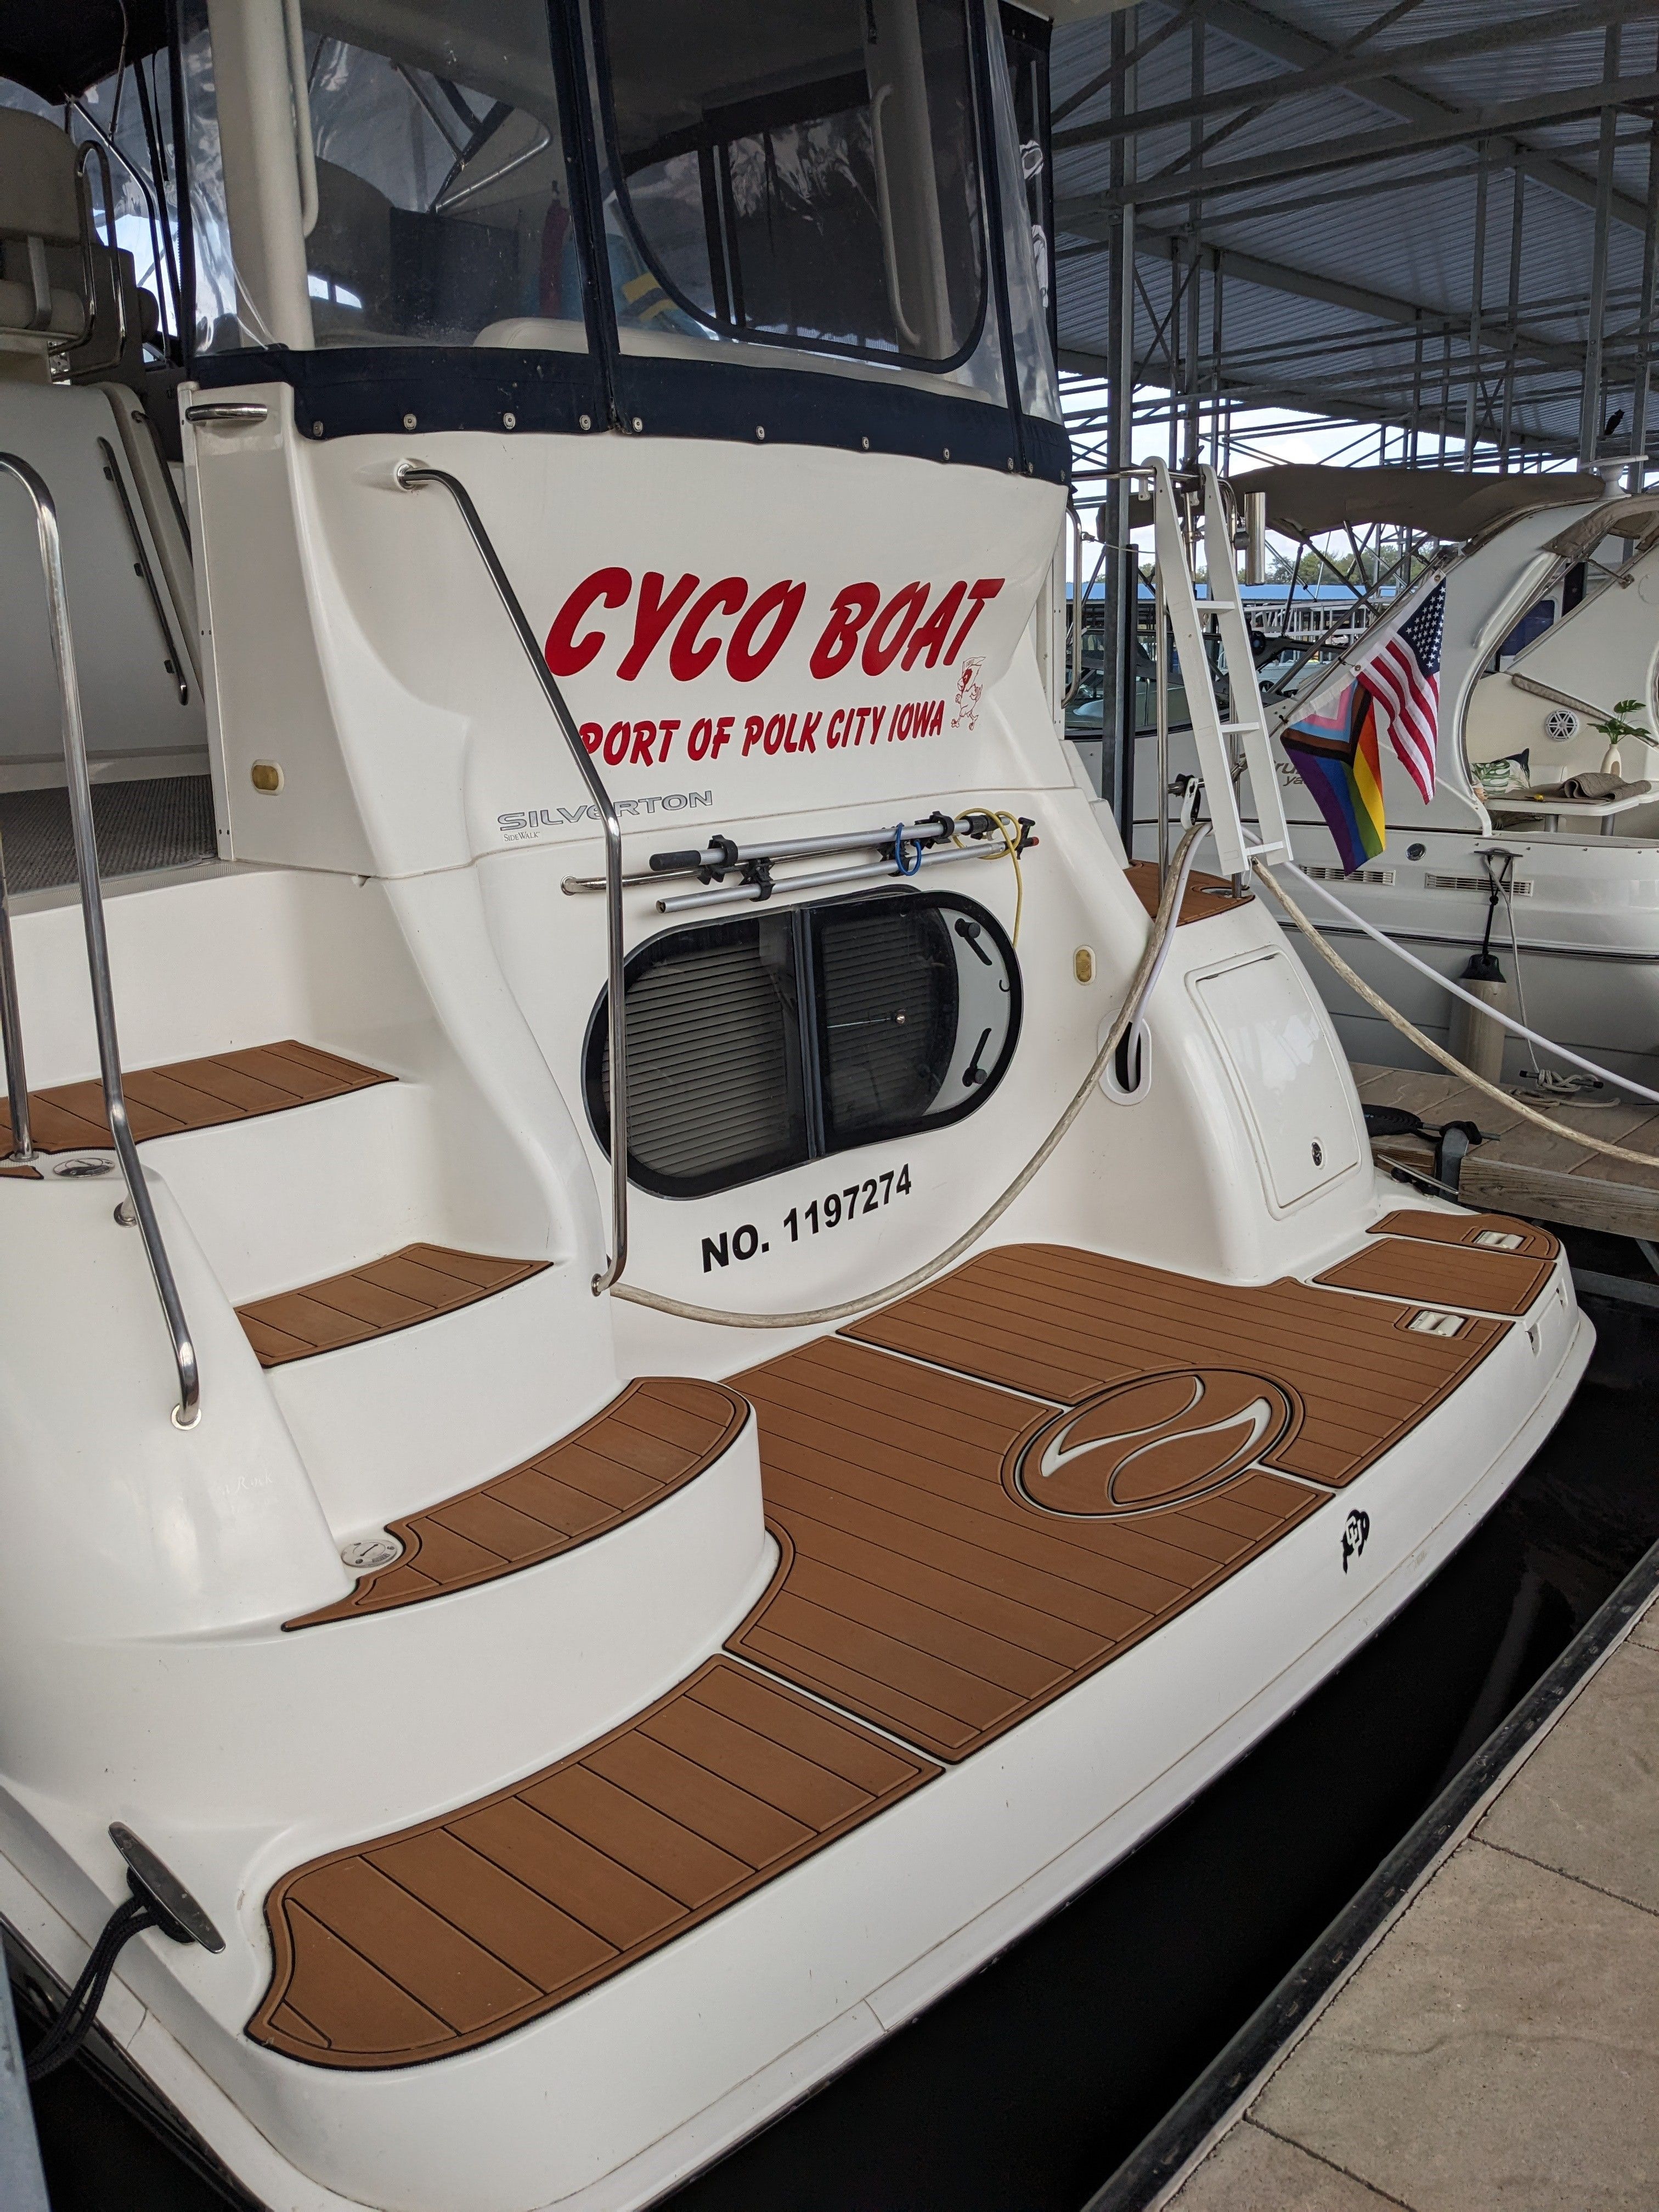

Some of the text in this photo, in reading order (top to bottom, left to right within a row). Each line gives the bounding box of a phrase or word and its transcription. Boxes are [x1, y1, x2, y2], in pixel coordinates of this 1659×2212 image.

[544, 567, 1003, 682] CYCO BOAT
[579, 700, 944, 766] PORT OF POLK CITY IOWA
[498, 791, 713, 831] SILVERTON
[702, 1164, 911, 1273] NO. 1197274
